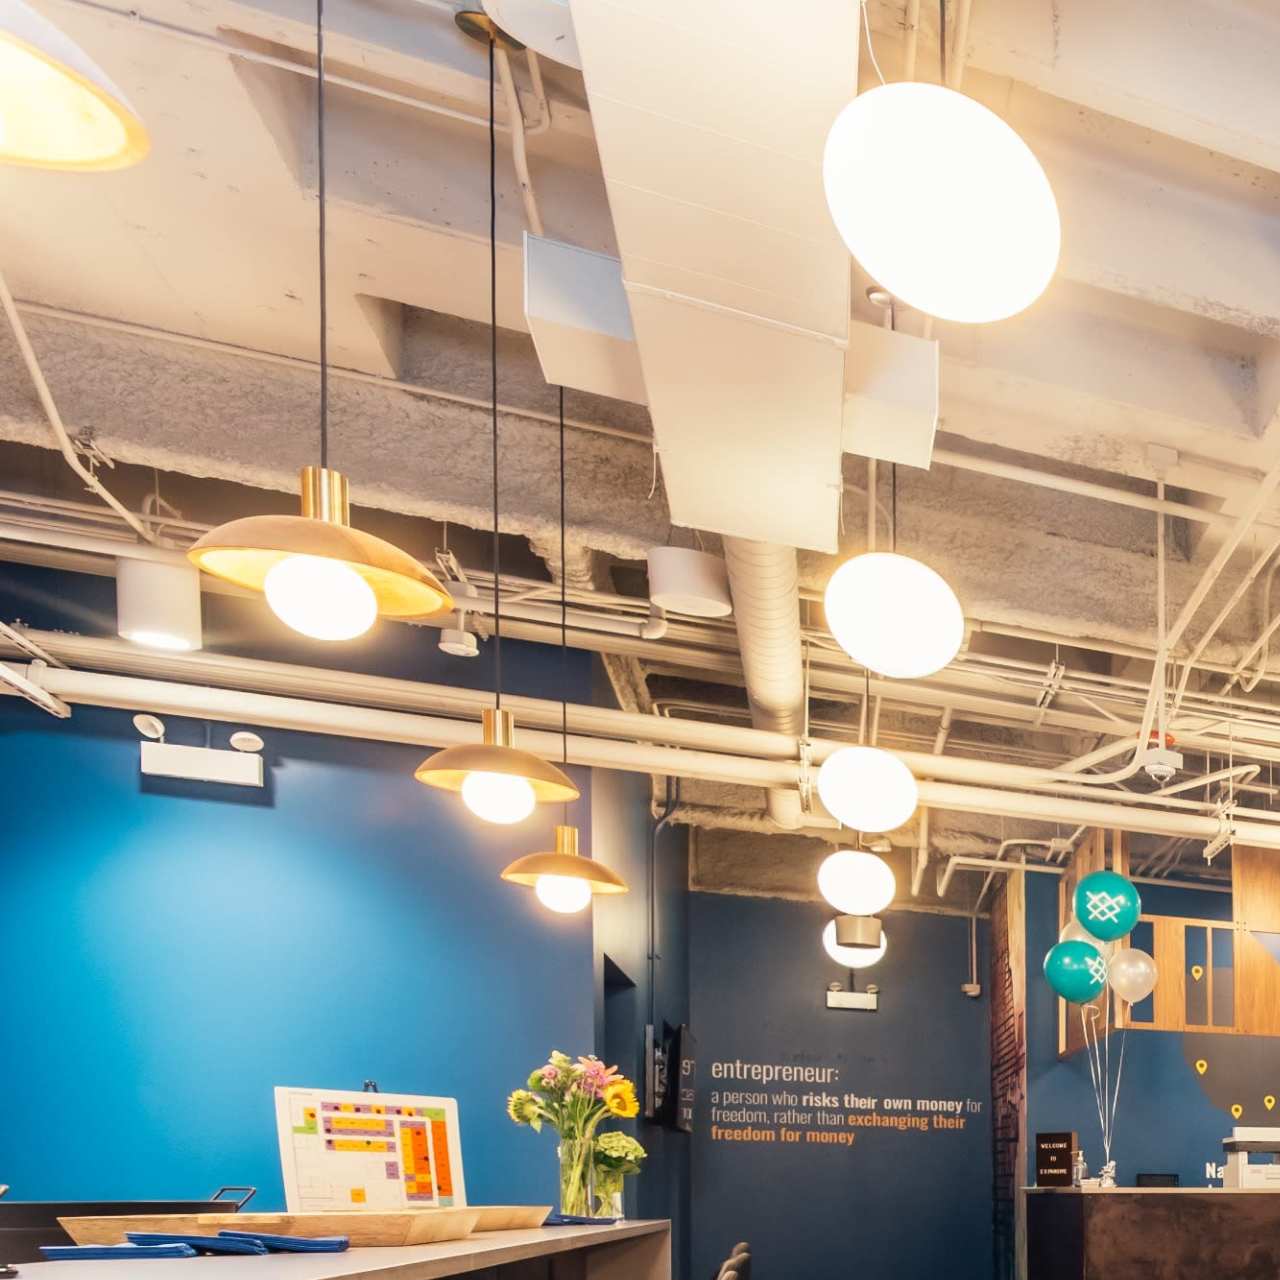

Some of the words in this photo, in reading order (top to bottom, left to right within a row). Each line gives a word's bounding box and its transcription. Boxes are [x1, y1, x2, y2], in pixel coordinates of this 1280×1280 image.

[711, 1059, 839, 1085] entrepreneur:
[711, 1091, 719, 1103] a
[723, 1091, 768, 1106] person
[771, 1090, 798, 1106] who
[802, 1091, 840, 1107] risks
[843, 1093, 878, 1109] their
[883, 1098, 912, 1110] own
[916, 1099, 963, 1114] money
[966, 1098, 983, 1113] for
[711, 1106, 770, 1124] freedom,
[774, 1109, 812, 1124] rather
[817, 1109, 845, 1126] than
[847, 1112, 929, 1131] exchanging
[933, 1114, 966, 1129] their
[711, 1125, 775, 1141] freedom
[780, 1127, 802, 1141] for
[806, 1131, 855, 1146] money
